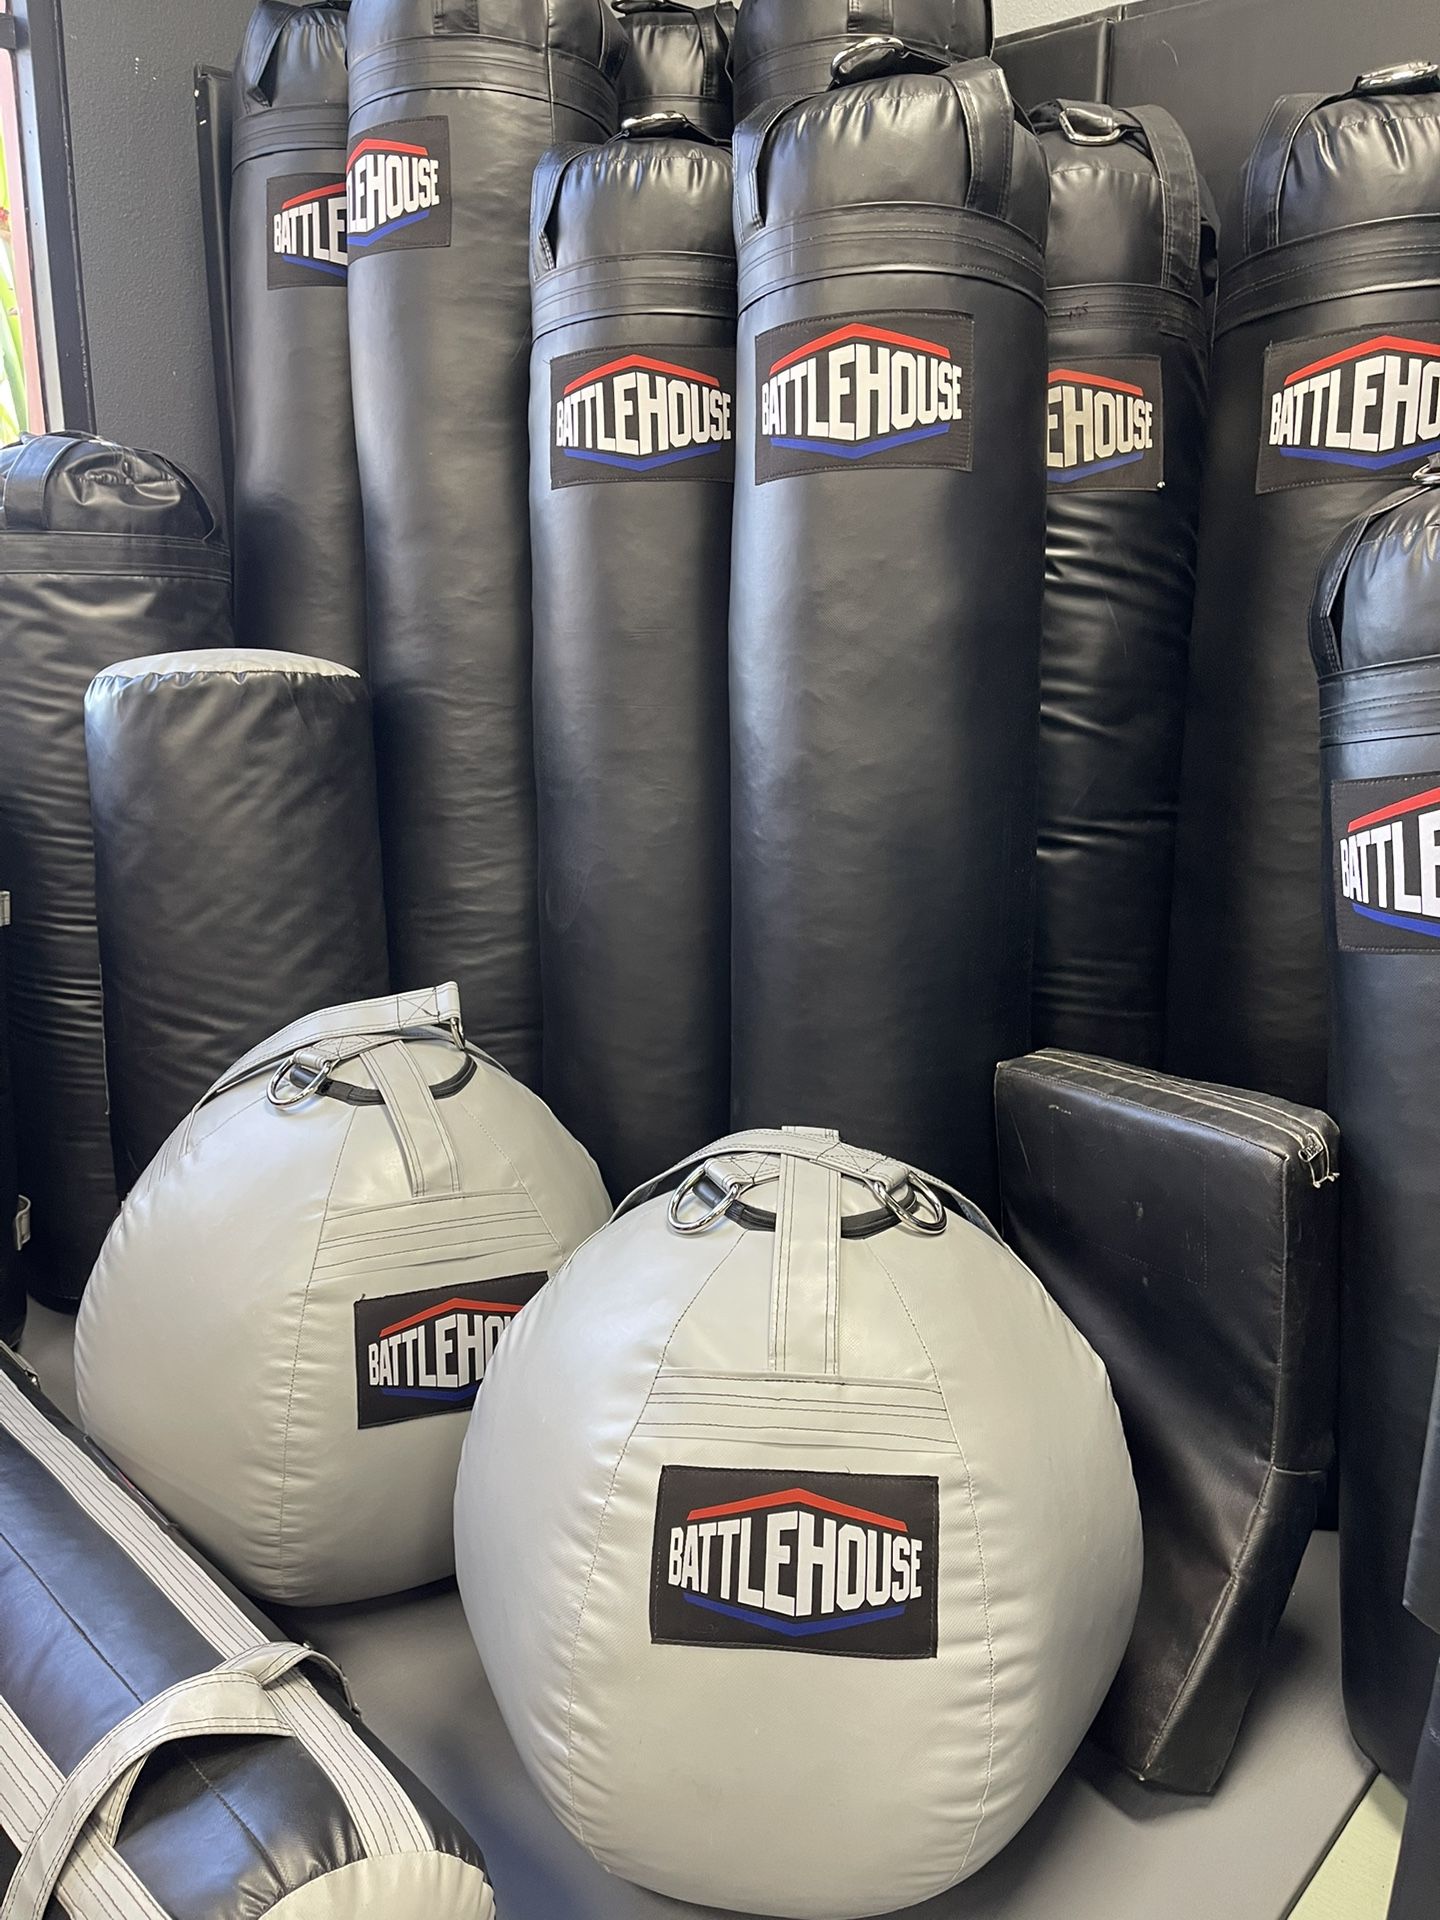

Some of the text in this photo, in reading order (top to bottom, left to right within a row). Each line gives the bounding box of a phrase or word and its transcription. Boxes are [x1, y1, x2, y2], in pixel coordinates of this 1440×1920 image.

[274, 196, 348, 266] BATTLE
[346, 154, 440, 234] LEHOUSE
[556, 371, 732, 456] BATTLEHOUSE
[761, 343, 962, 441] BATTLEHOUSE
[1047, 385, 1153, 468] EHOUSE
[1269, 355, 1440, 452] BATTLEHO
[1340, 809, 1440, 918] BATTLE
[368, 1313, 511, 1388] BATTLEHO
[668, 1510, 923, 1617] BATTLEHOUSE
